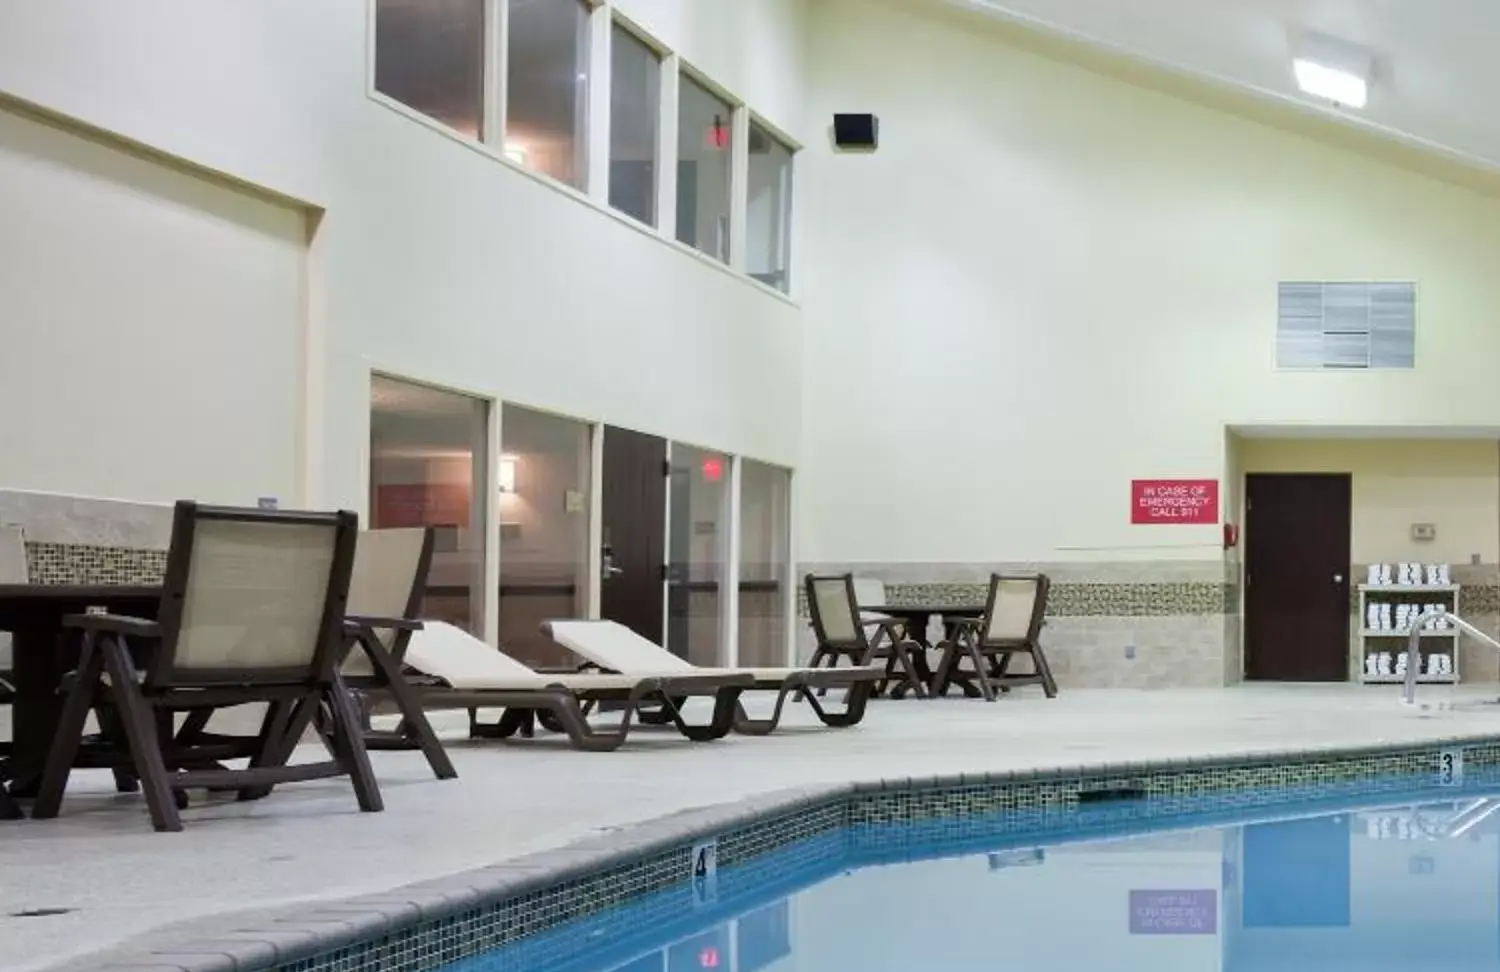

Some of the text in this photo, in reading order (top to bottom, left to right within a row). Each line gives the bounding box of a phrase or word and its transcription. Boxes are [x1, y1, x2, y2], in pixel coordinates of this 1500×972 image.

[1143, 485, 1207, 497] IN CASE OF
[1139, 496, 1211, 508] EMERGENCY
[1149, 507, 1201, 518] CALL 911
[695, 847, 707, 877] 4
